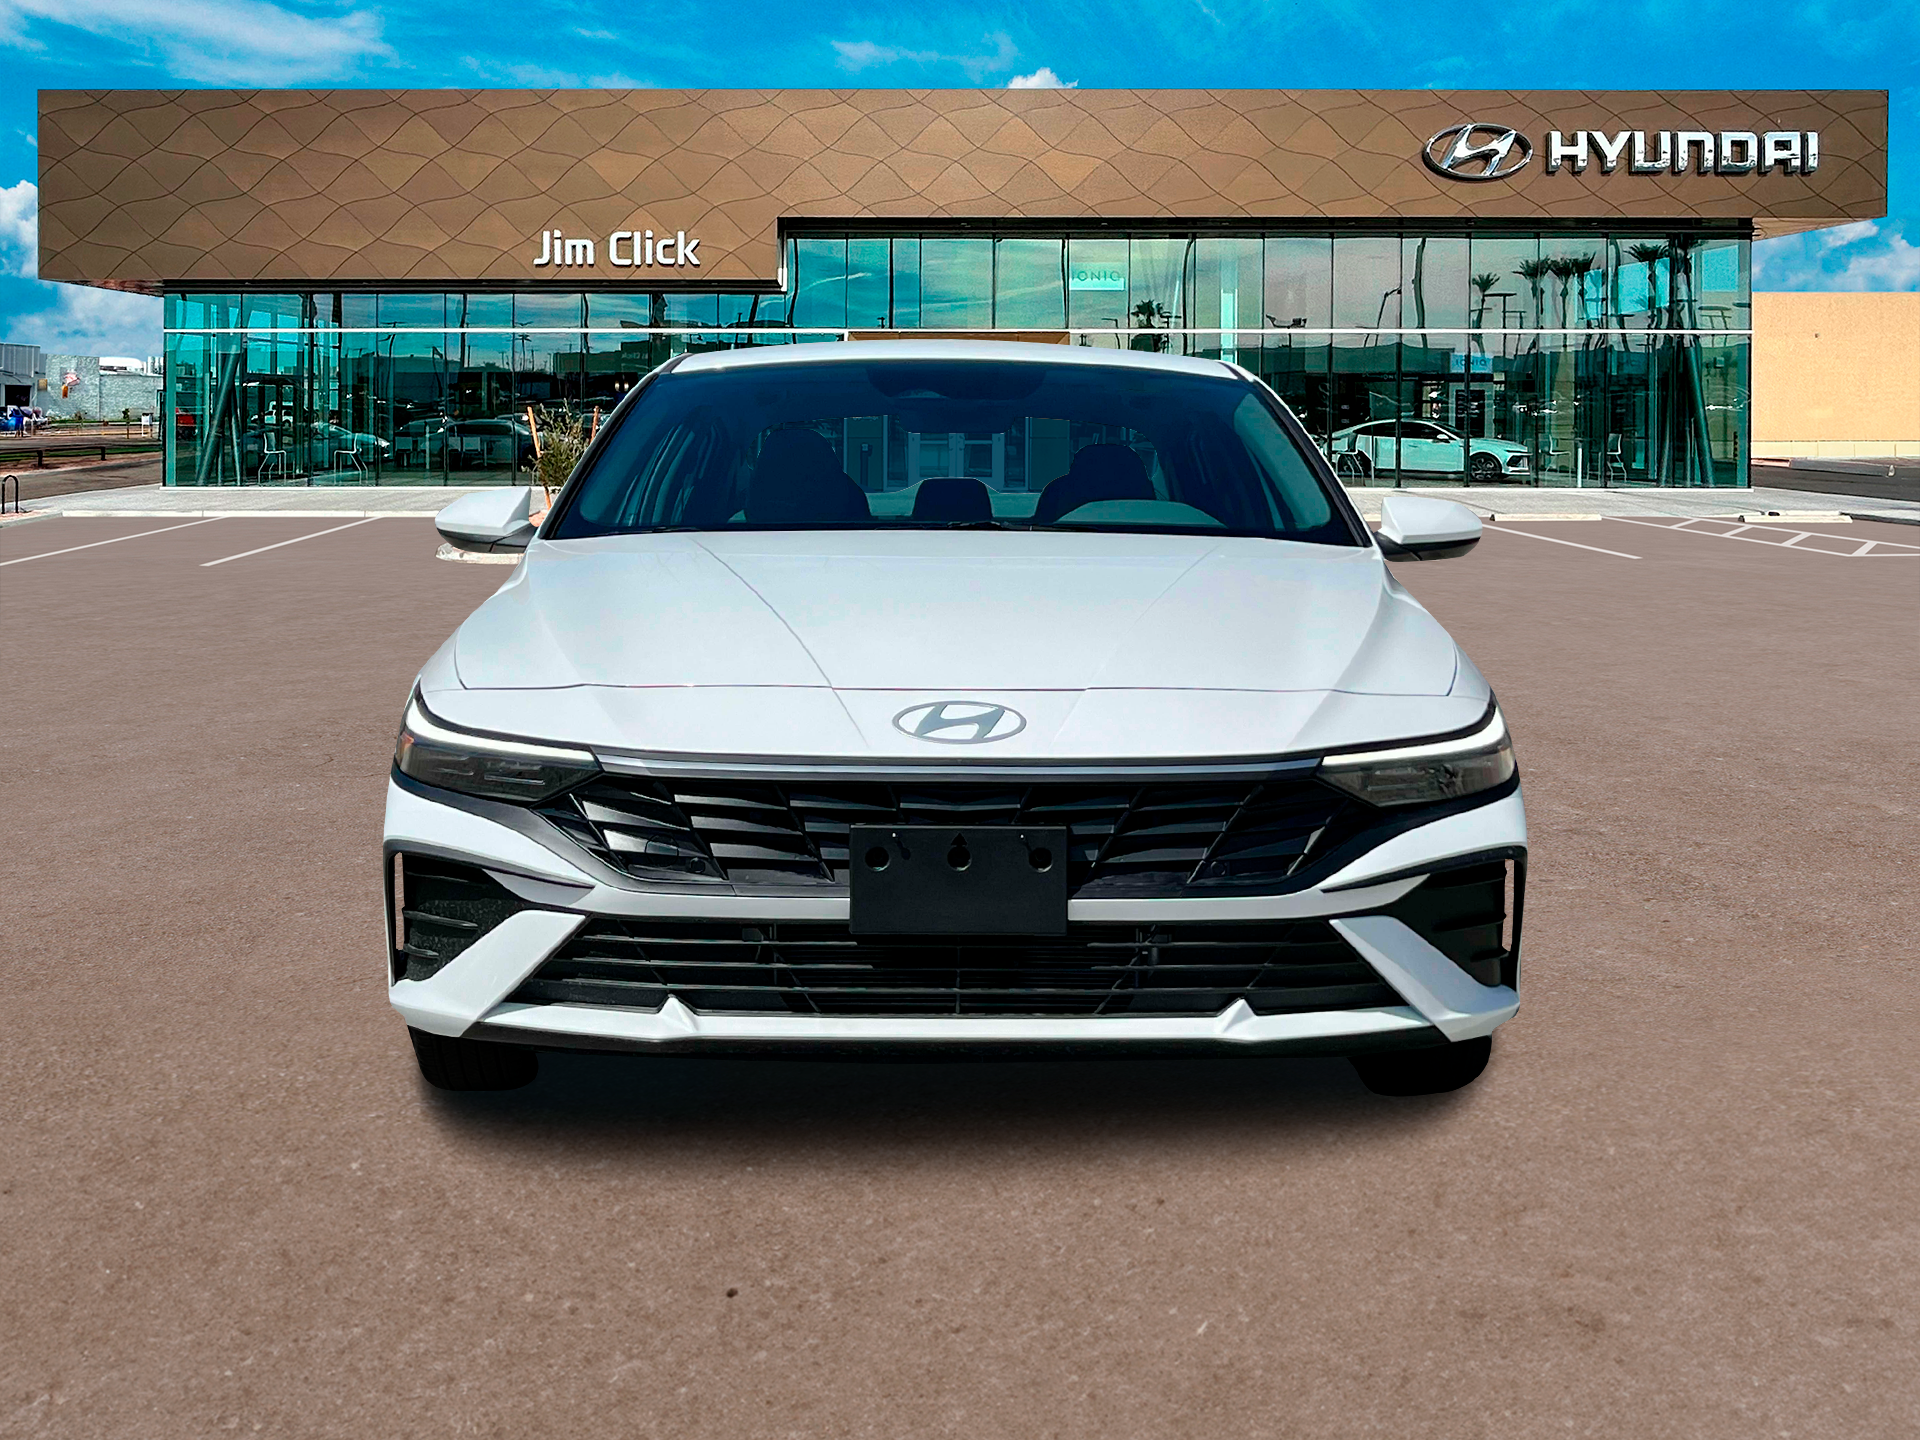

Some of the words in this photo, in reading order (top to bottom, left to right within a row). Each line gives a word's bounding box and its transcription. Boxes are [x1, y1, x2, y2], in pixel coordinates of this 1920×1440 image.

[1547, 130, 1820, 174] HYUNDAI
[533, 229, 595, 267] Jim
[609, 229, 701, 267] Click
